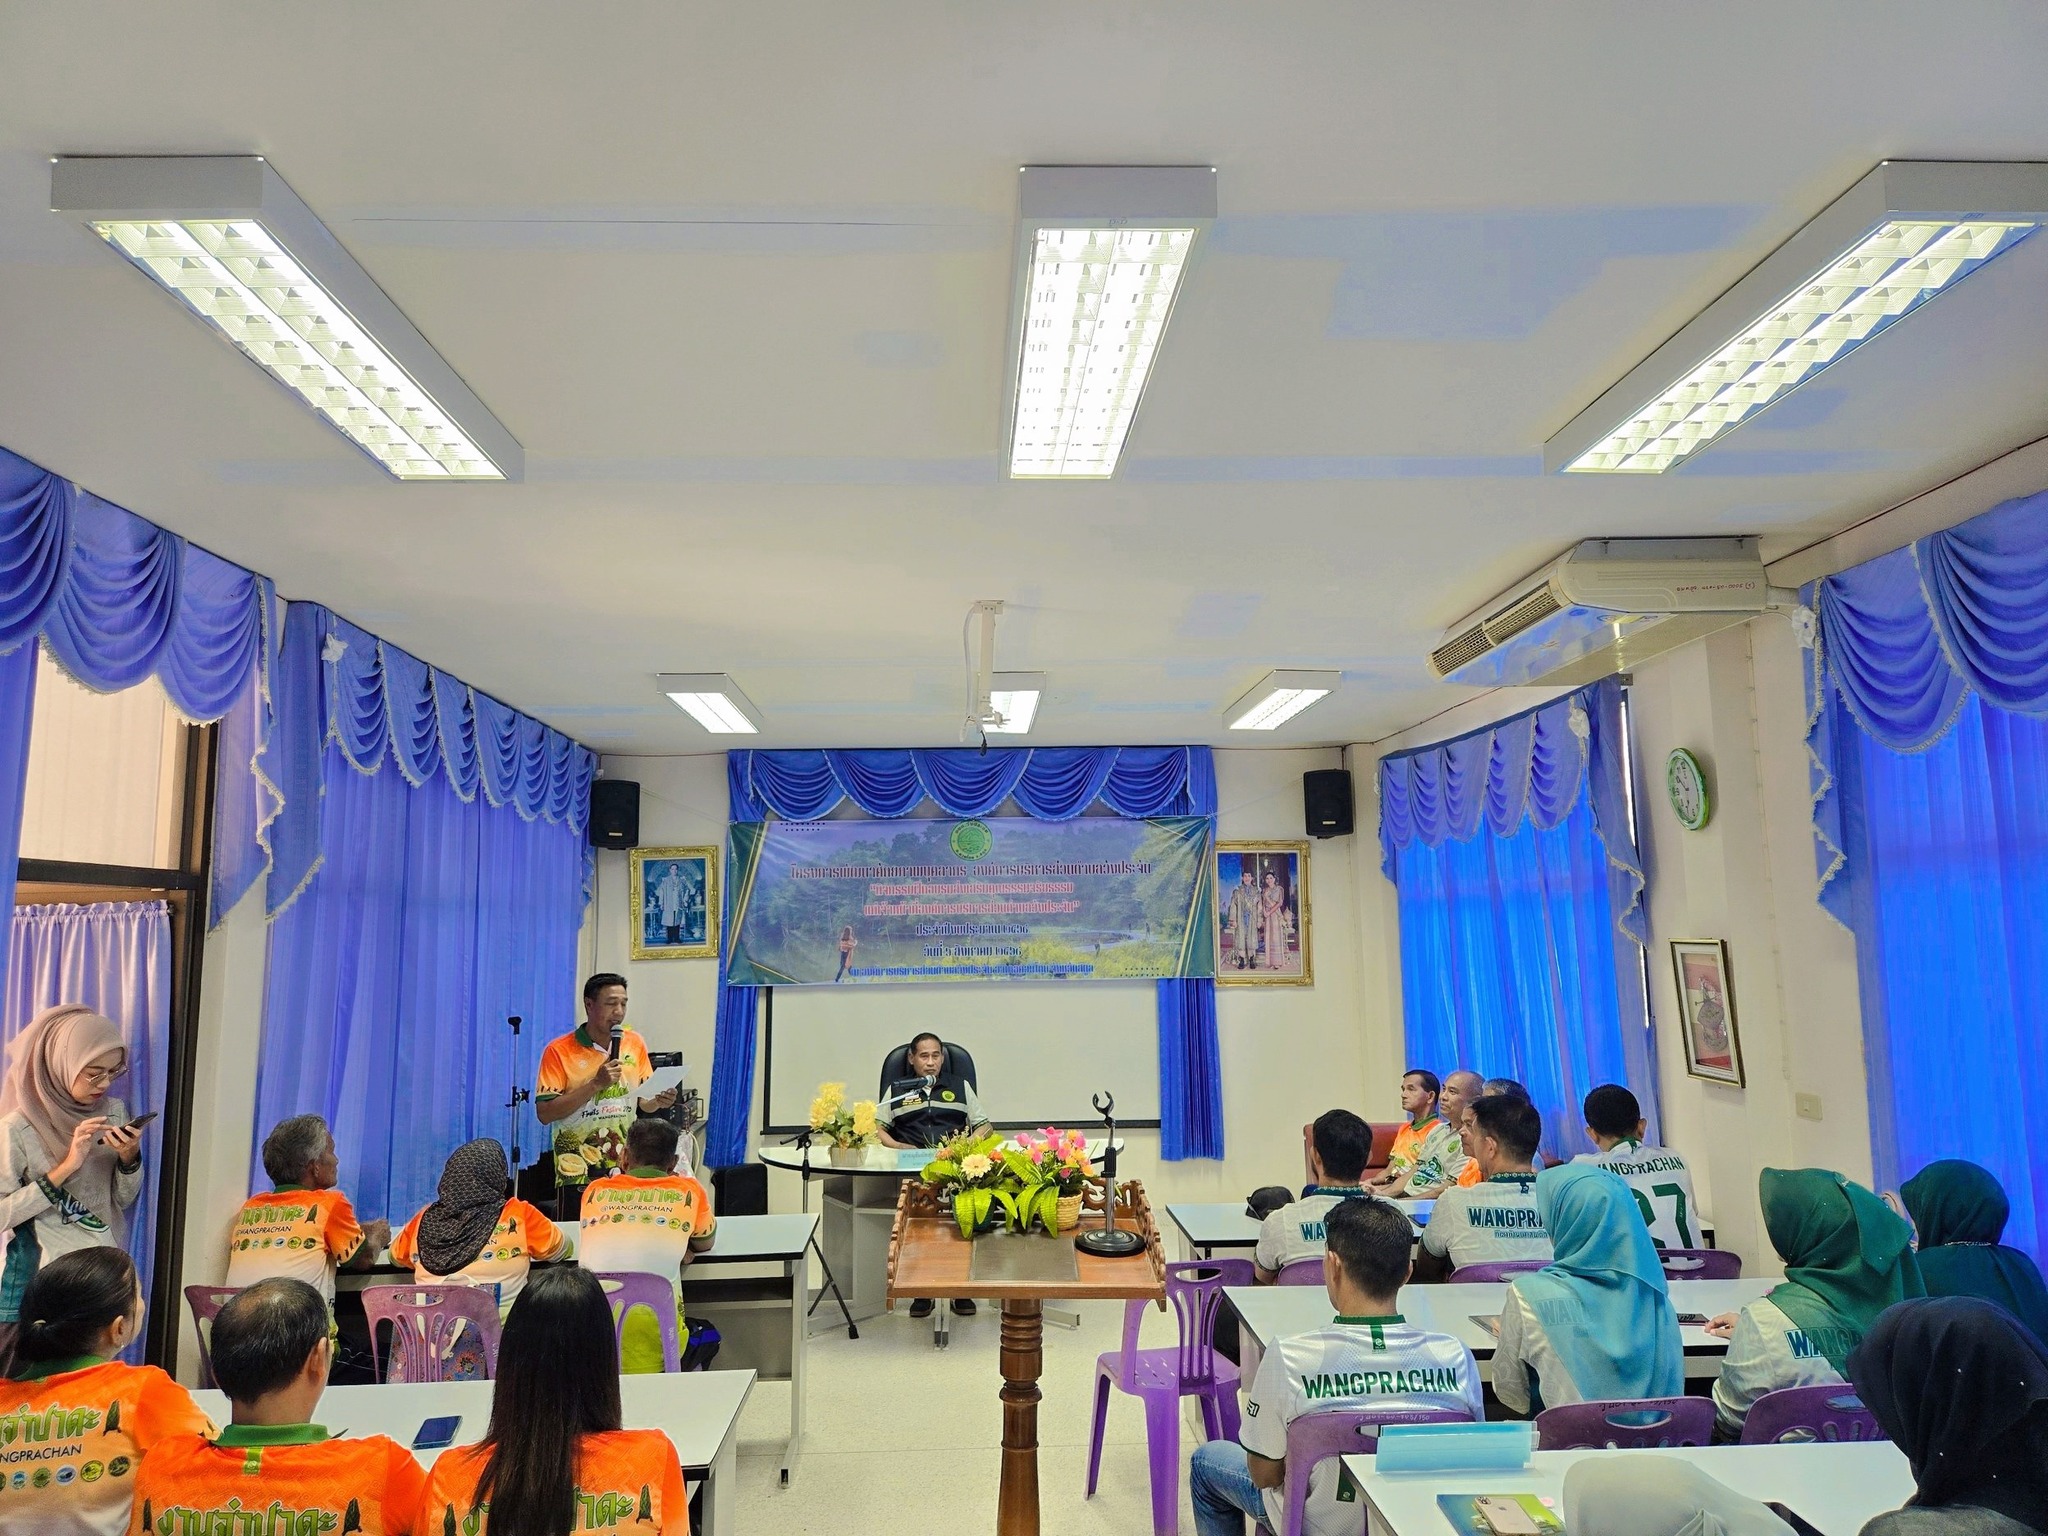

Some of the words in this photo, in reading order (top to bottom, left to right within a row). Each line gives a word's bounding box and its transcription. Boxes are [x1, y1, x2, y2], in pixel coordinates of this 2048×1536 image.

[924, 940, 942, 957] วันที่
[954, 944, 992, 956] สิงหาคม
[1301, 1367, 1459, 1399] WANGPRACHAN
